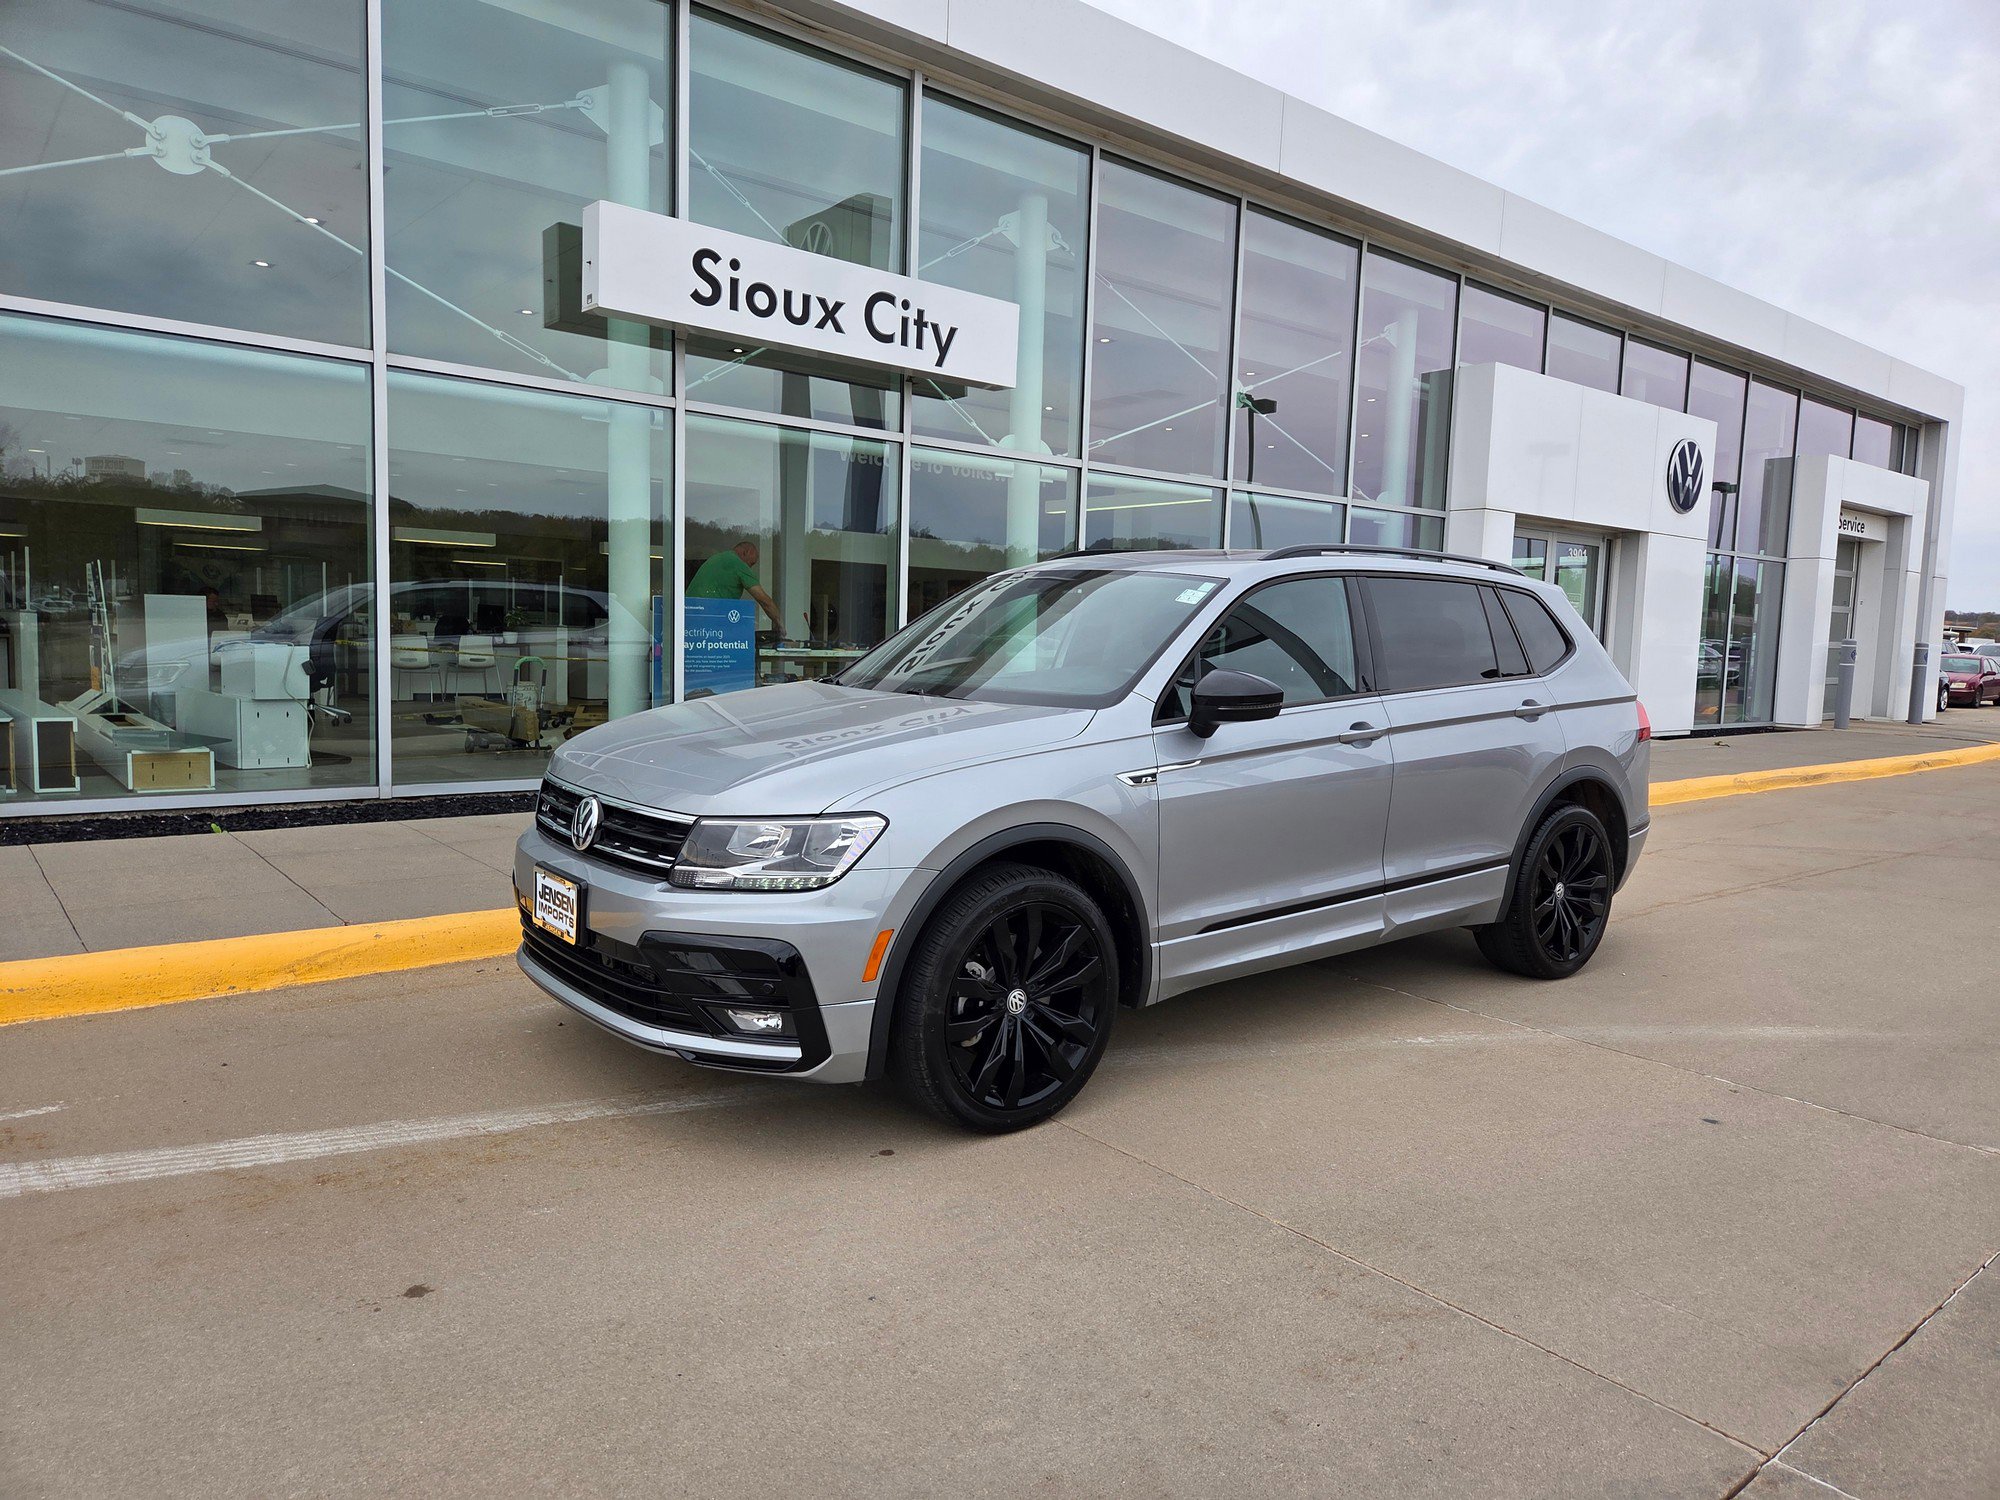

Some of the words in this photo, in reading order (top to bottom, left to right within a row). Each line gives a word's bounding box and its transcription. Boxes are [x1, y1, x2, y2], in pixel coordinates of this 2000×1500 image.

[690, 247, 846, 335] Sioux
[864, 290, 958, 368] City
[1838, 511, 1865, 534] Service
[684, 628, 724, 640] ectrifying
[696, 640, 707, 649] of
[708, 640, 749, 651] potential
[539, 883, 575, 916] JENSEN
[538, 901, 575, 929] IMPORTS
